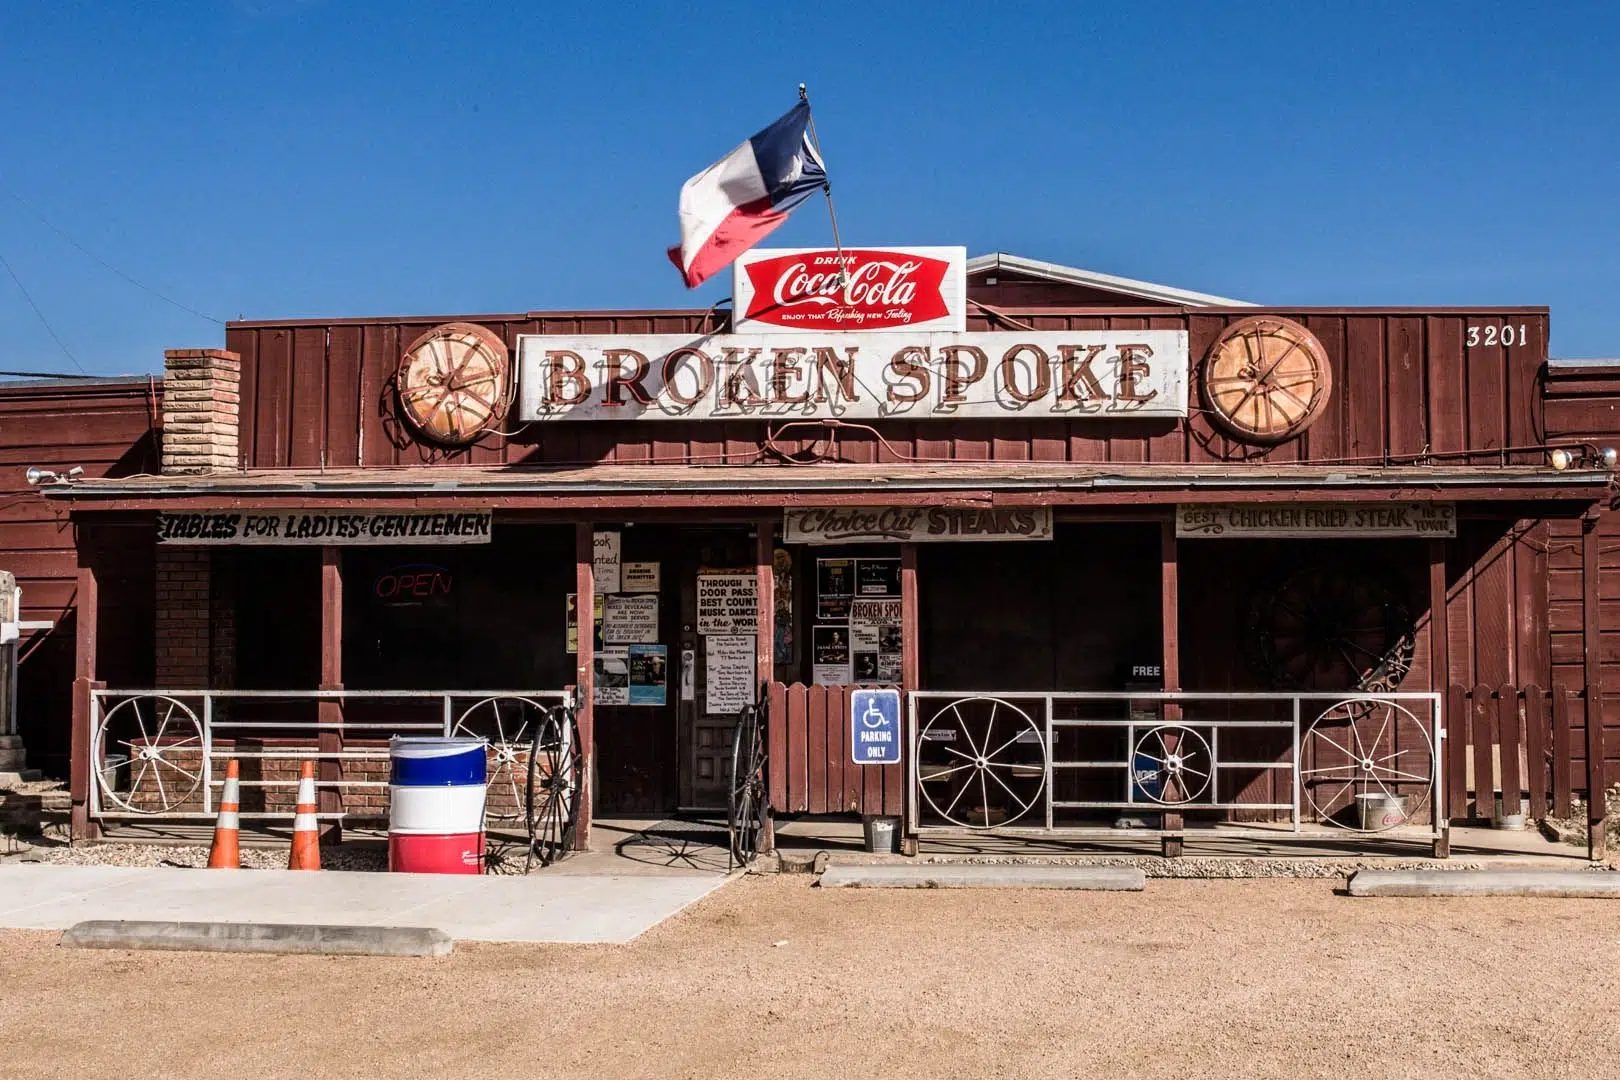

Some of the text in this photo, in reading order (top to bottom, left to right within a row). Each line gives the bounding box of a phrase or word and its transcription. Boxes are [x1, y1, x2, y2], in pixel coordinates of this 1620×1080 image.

[814, 256, 858, 265] DRINK
[826, 308, 865, 323] Refreshing
[884, 308, 913, 323] Feeling
[1466, 324, 1526, 347] 3201
[544, 343, 1158, 407] BROKEN SPOKE
[799, 507, 923, 533] Choice Cut
[1183, 511, 1219, 524] BEST
[1228, 507, 1412, 528] CHICKEN FRIED STEAK
[162, 513, 241, 539] TABLES
[243, 515, 280, 538] FOR
[284, 515, 365, 538] LADIES
[369, 514, 490, 537] GENTLEMEN
[593, 534, 612, 549] ook
[594, 553, 618, 565] nted
[376, 573, 453, 597] OPEN
[700, 579, 742, 587] THROUGH
[700, 588, 753, 597] DOOR PASS
[700, 598, 758, 607] BEST COUNT
[700, 608, 758, 617] MUSIC DANCE
[853, 603, 902, 617] BROKEN SPO
[699, 618, 758, 627] in the WORL
[1132, 665, 1161, 676] FREE
[861, 731, 892, 742] PARKING
[867, 746, 886, 758] ONLY
